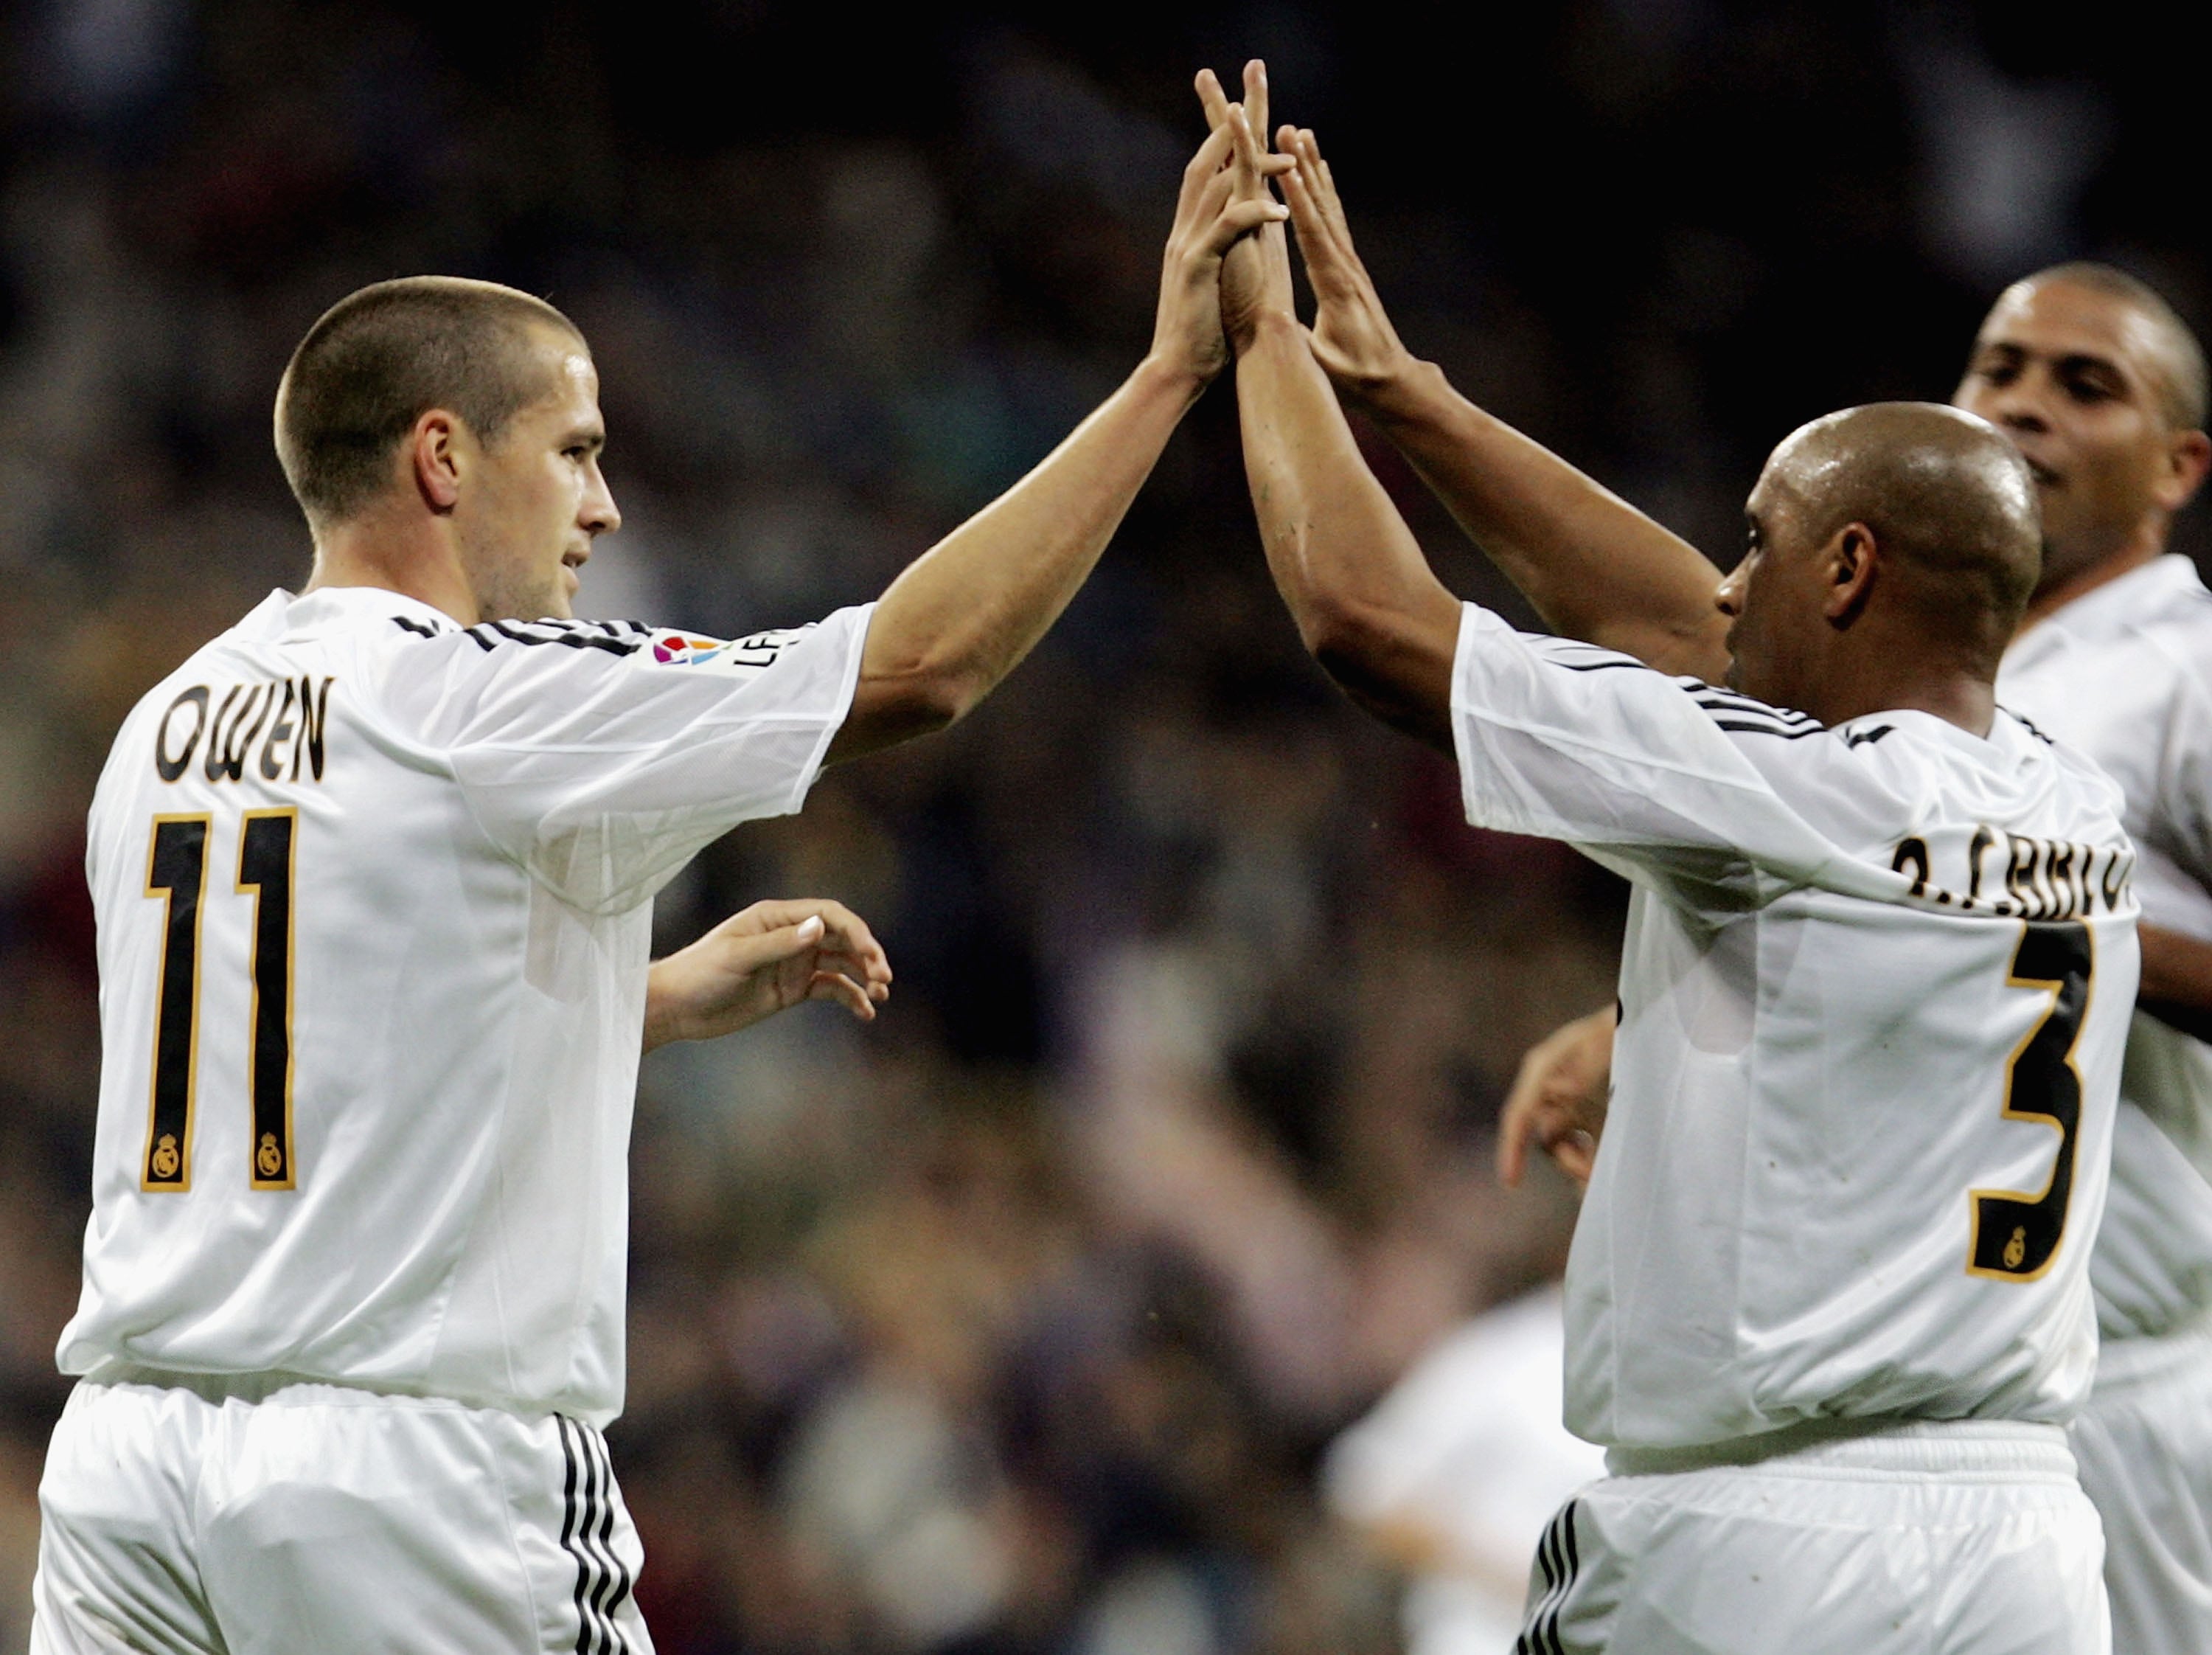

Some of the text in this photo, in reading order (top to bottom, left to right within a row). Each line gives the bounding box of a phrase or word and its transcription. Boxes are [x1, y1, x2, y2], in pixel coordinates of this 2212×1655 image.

[155, 676, 335, 784] OWEN
[733, 636, 799, 667] LF
[140, 806, 299, 1193] 11
[1966, 917, 2097, 1283] 3
